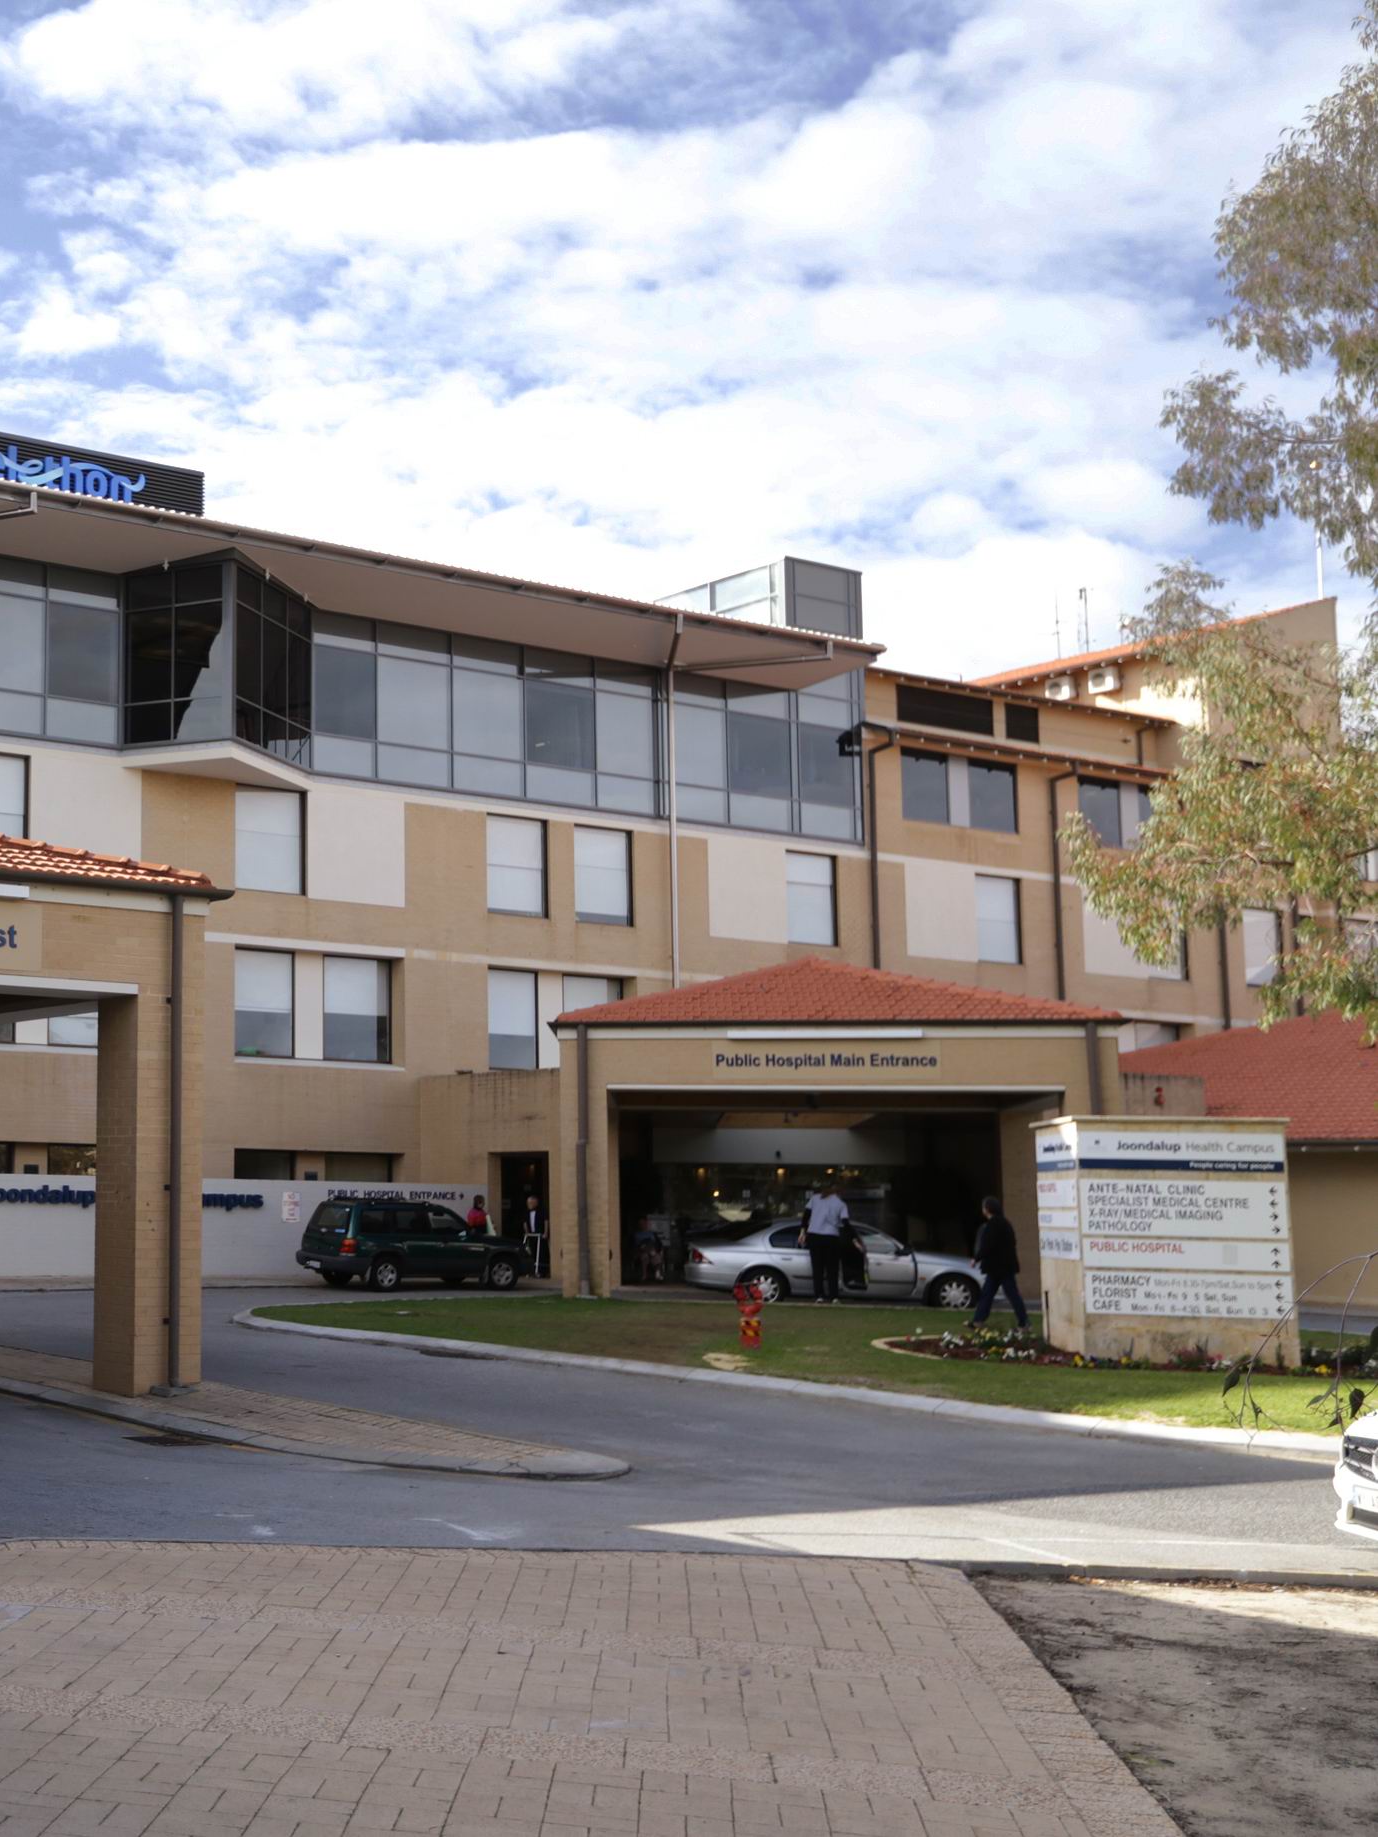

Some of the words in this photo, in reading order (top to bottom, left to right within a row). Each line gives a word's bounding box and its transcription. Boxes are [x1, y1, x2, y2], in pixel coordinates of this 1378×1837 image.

[716, 1053, 761, 1067] Public
[765, 1053, 825, 1070] Hospital
[830, 1054, 865, 1068] Main
[870, 1054, 937, 1068] Entrance
[1117, 1140, 1181, 1154] Joondalup
[1186, 1141, 1223, 1153] Health
[1226, 1142, 1275, 1155] Campus
[328, 1189, 358, 1199] PUBLIC
[363, 1190, 404, 1200] HOSPITAL
[1088, 1184, 1161, 1196] ANTE-NATAL
[1167, 1184, 1206, 1196] CLINIC
[202, 1193, 264, 1211] mpus
[1087, 1195, 1150, 1206] SPECIALIST
[1152, 1197, 1202, 1208] MEDICAL
[1204, 1198, 1250, 1209] CENTRE
[1175, 1210, 1224, 1221] IMAGING
[1088, 1220, 1153, 1232] PATHOLOGY
[1090, 1241, 1129, 1253] PUBLIC
[1132, 1242, 1185, 1254] HOSPITAL
[1091, 1275, 1151, 1287] PHARMACY
[1092, 1287, 1137, 1299] FLORIST
[1093, 1299, 1121, 1311] CAFE
